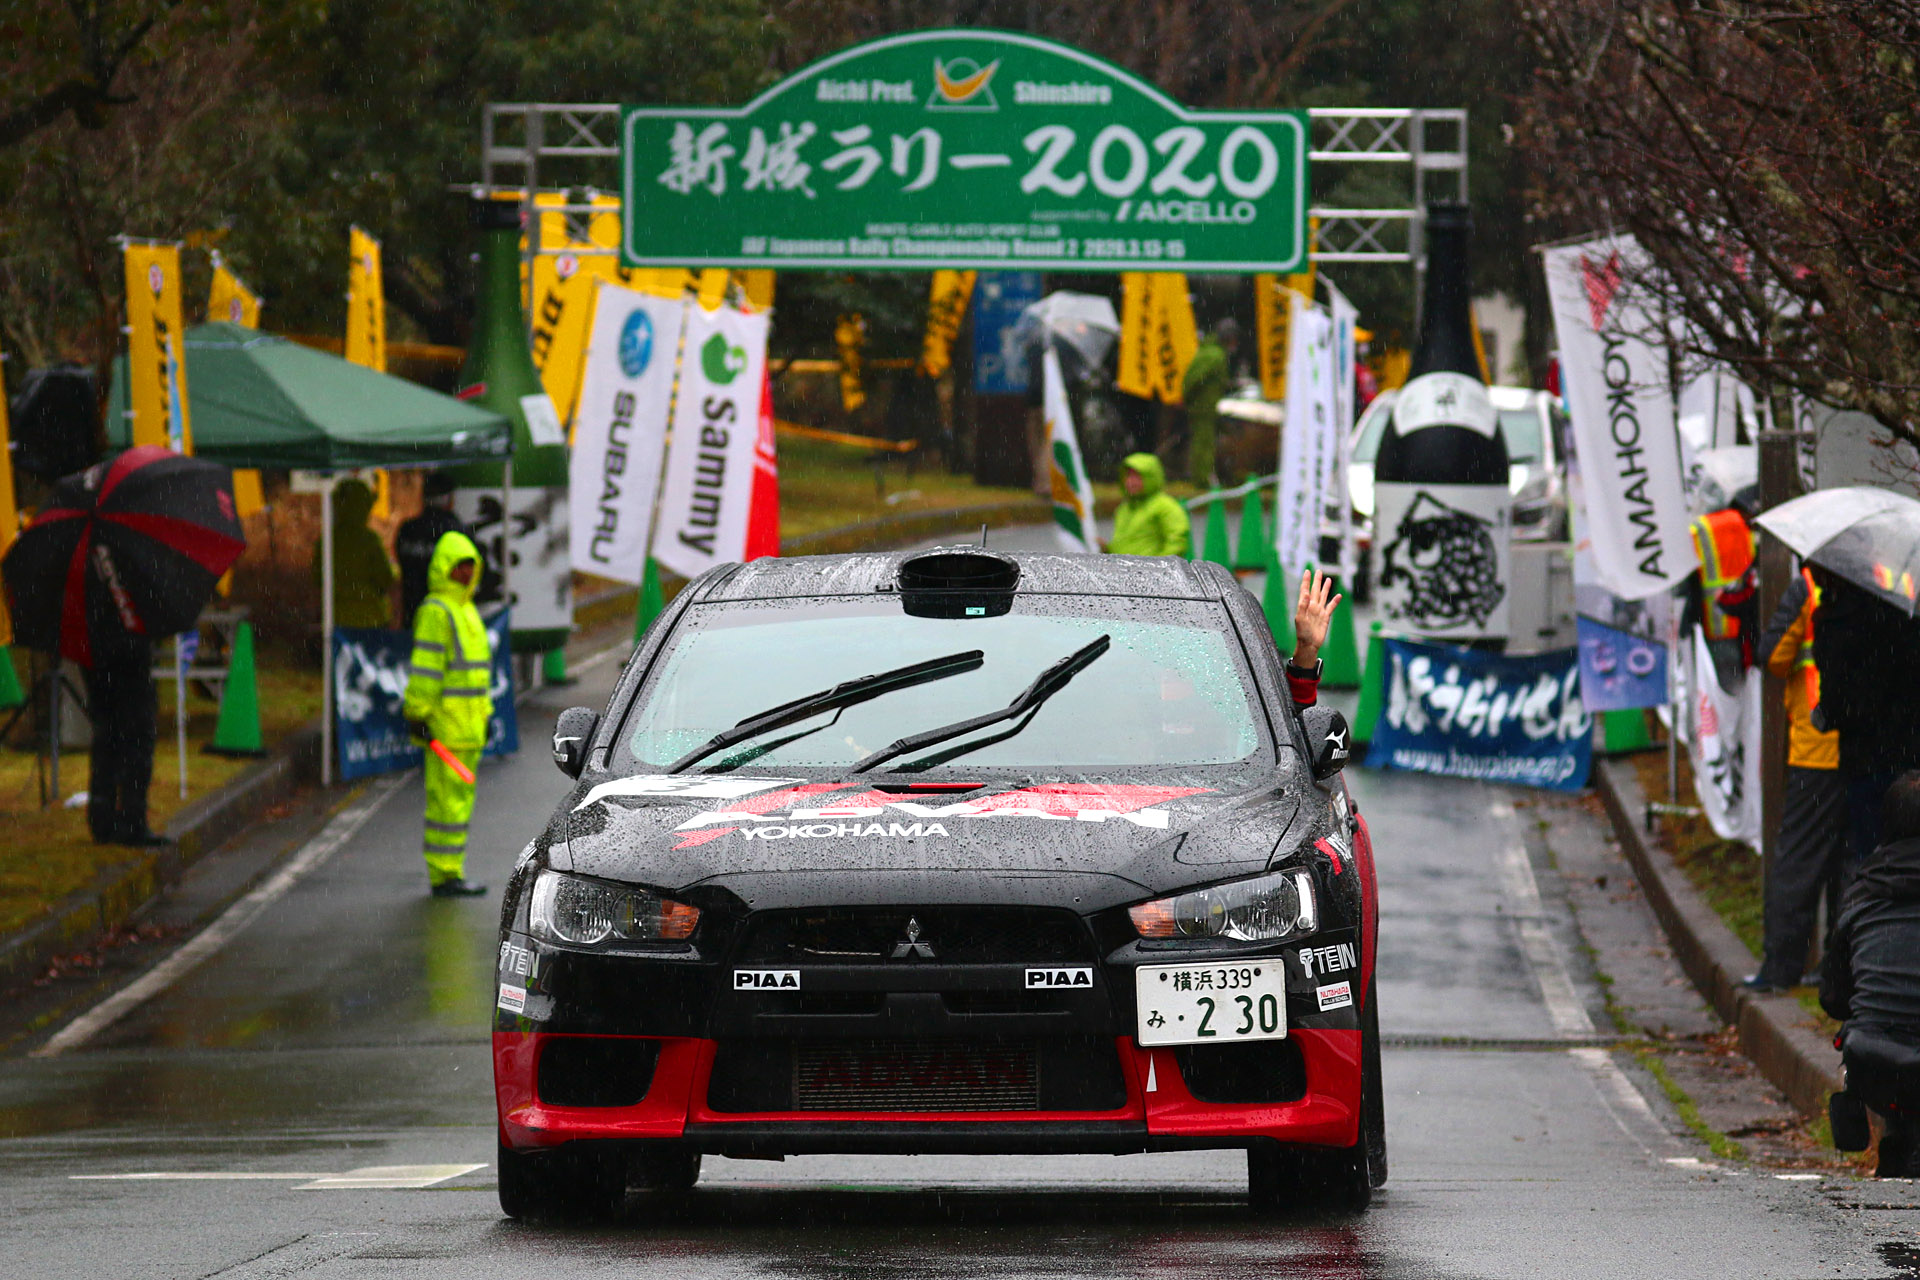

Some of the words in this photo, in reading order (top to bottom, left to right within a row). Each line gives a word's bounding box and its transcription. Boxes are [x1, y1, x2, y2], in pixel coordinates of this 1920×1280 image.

[1136, 200, 1258, 224] AICELLO
[1601, 331, 1668, 580] YOKOHAMA
[589, 389, 637, 564] SUBARU
[676, 395, 736, 557] Sammy
[740, 822, 950, 841] YOKOHAMA
[1313, 942, 1357, 974] TEIN
[735, 972, 798, 988] PIAA
[1027, 970, 1091, 986] PIAA
